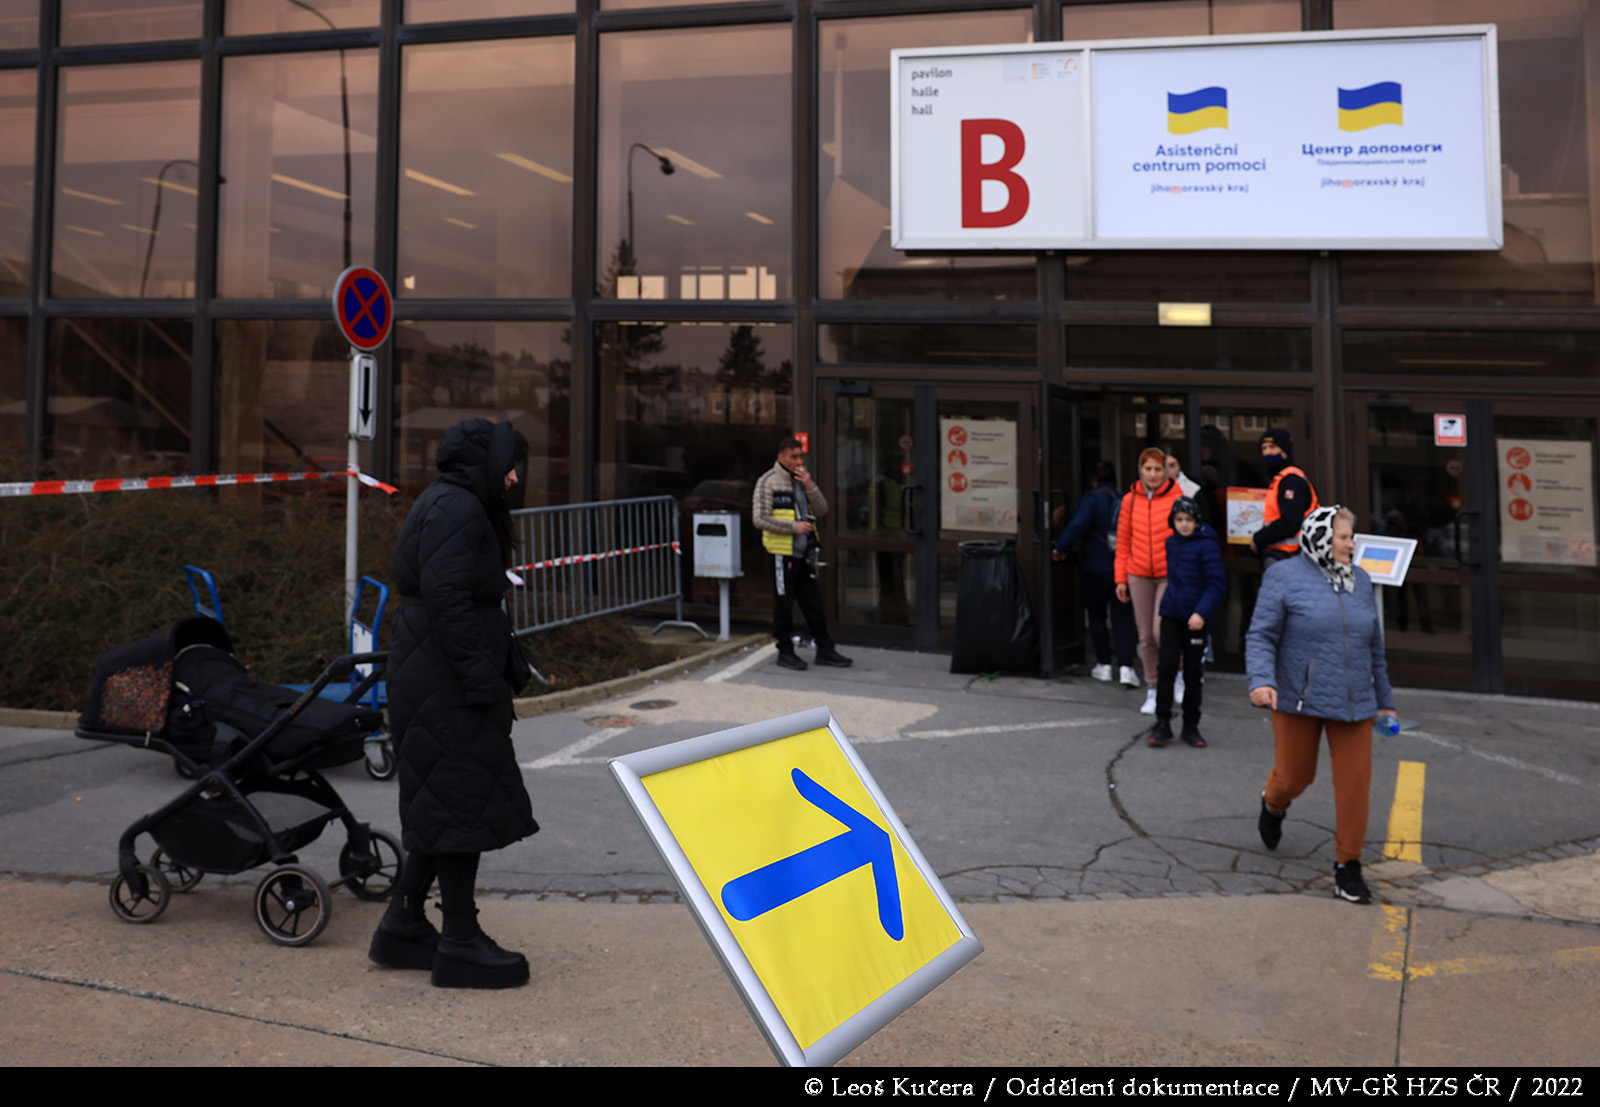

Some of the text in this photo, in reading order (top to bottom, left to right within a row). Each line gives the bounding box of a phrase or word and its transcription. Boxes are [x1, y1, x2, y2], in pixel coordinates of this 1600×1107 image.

[911, 67, 953, 81] pavilon
[911, 86, 939, 97] halle
[911, 104, 933, 116] hall
[1155, 143, 1238, 157] Asistenční
[1301, 143, 1443, 157] Центр допомоги
[1132, 158, 1267, 174] centrum pomoci
[960, 118, 1030, 229] B
[1227, 183, 1249, 194] kraj
[1402, 176, 1426, 189] kraj
